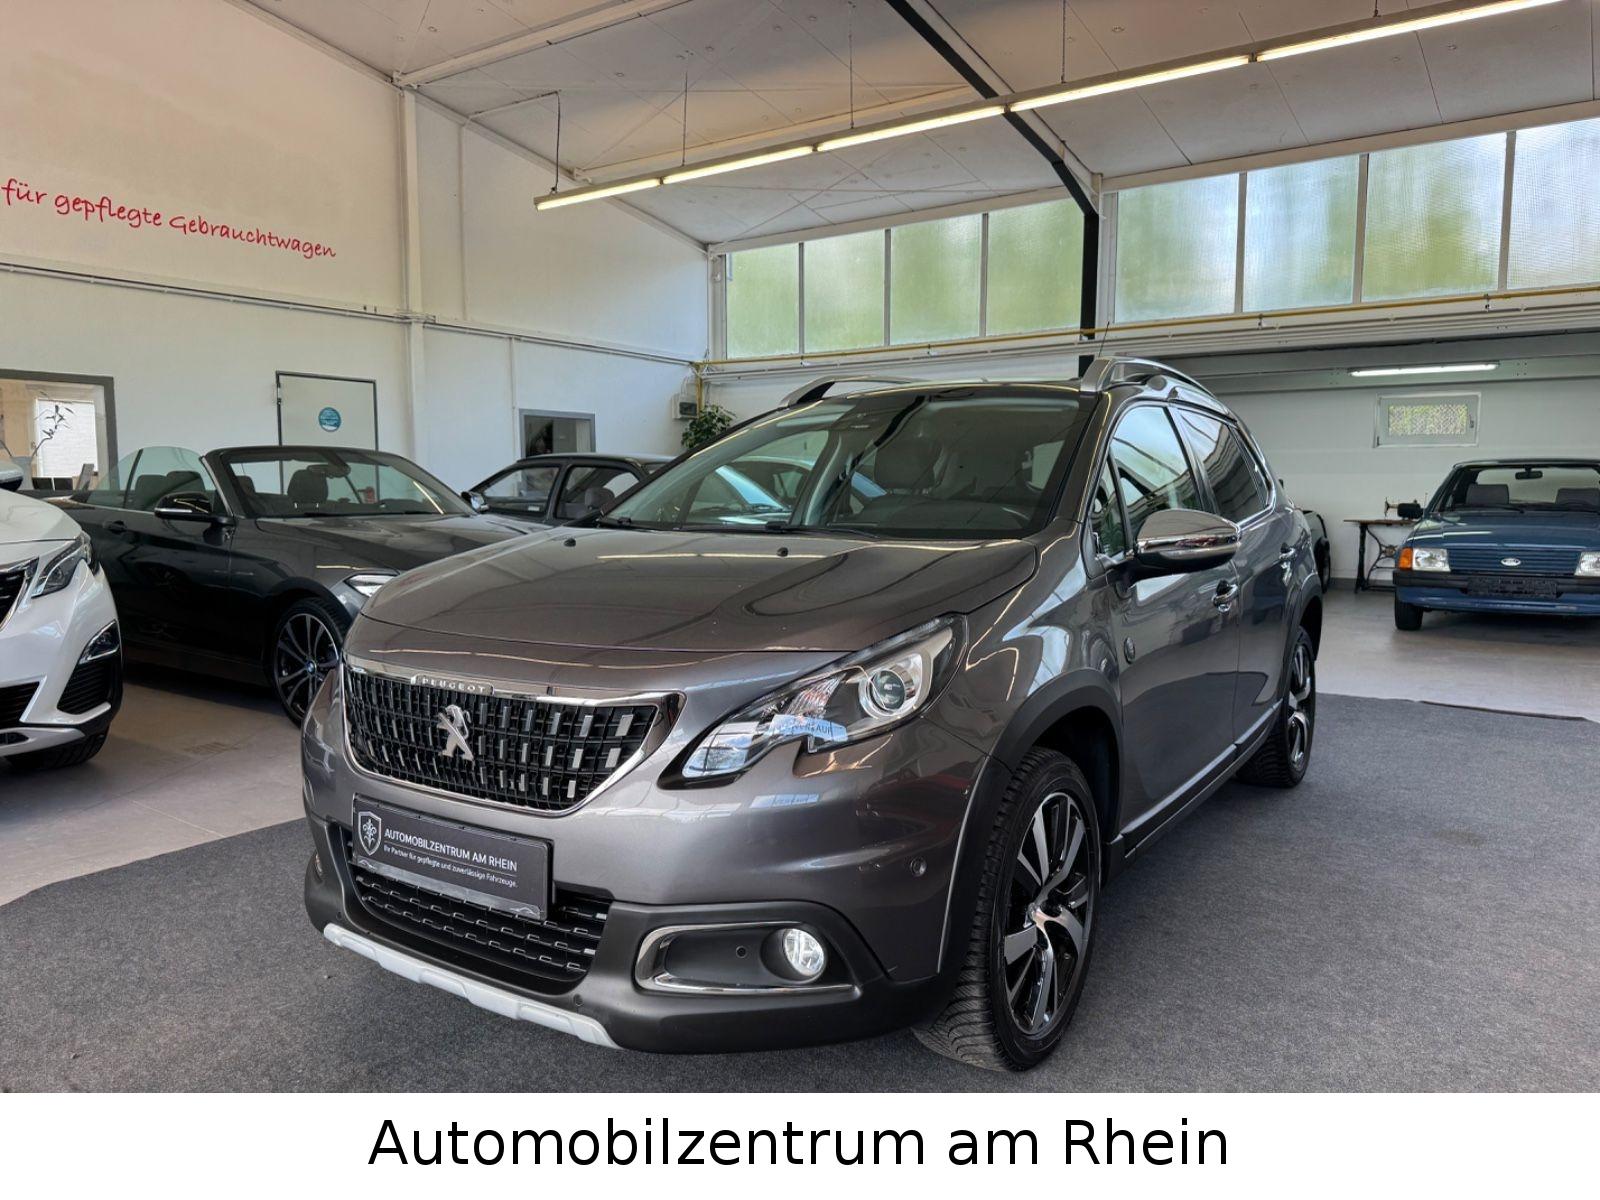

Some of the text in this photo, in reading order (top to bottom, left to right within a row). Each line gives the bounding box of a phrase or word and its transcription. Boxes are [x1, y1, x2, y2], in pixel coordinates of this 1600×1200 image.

[1, 178, 336, 259] für gepflegte Gebrauchtwagen
[422, 676, 485, 693] PEUGEOT
[384, 828, 518, 872] AUTOMOBILZENTRUM AM RHEIN
